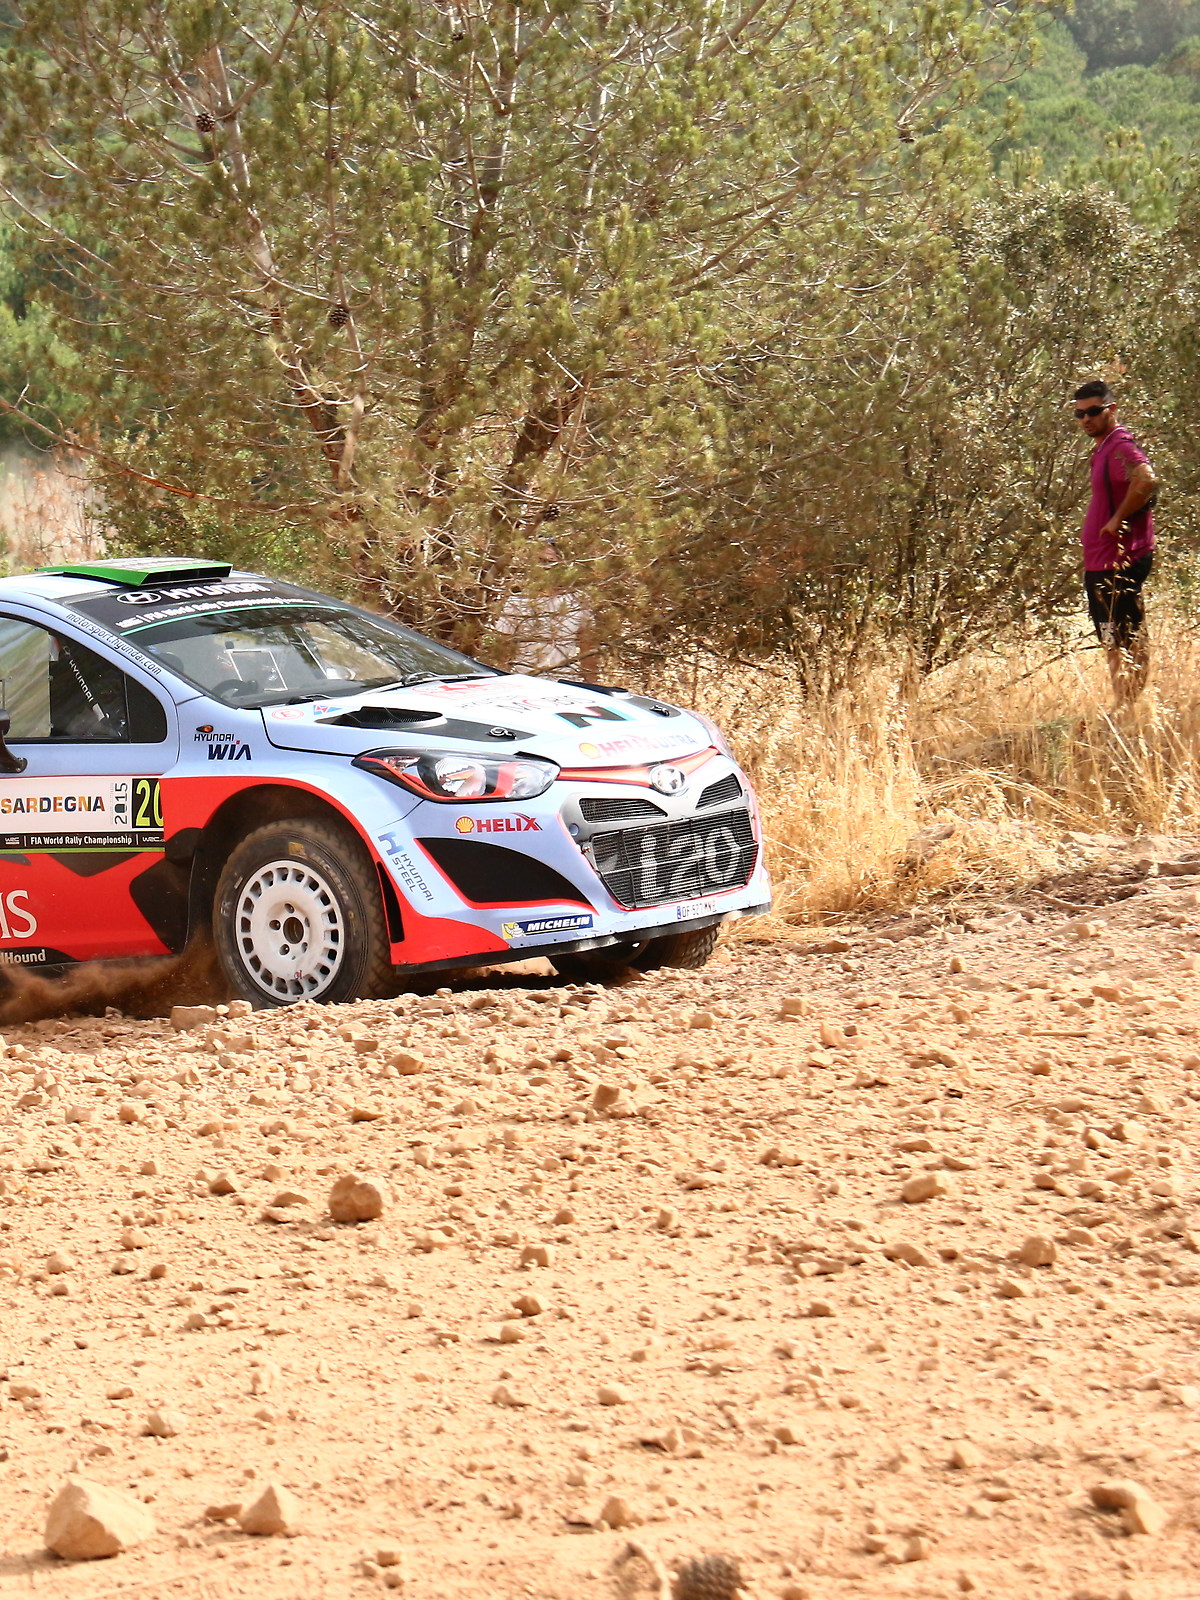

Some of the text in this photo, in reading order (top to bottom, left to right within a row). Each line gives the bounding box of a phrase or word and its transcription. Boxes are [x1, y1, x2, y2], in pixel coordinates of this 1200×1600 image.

[160, 583, 271, 600] HYUNDAI
[66, 613, 162, 676] motorsport.hyundai.com
[69, 659, 94, 702] HYUNDAI
[194, 733, 235, 742] HYUNDAI
[208, 742, 252, 760] WIA
[0, 795, 106, 815] SARDEGNA
[114, 782, 128, 825] 2015
[476, 813, 542, 833] HELIX
[30, 834, 133, 846] FIA World Rally Championship
[392, 856, 416, 893] STEEL
[401, 853, 434, 902] HYUNDAI
[526, 916, 591, 932] MICHELIN
